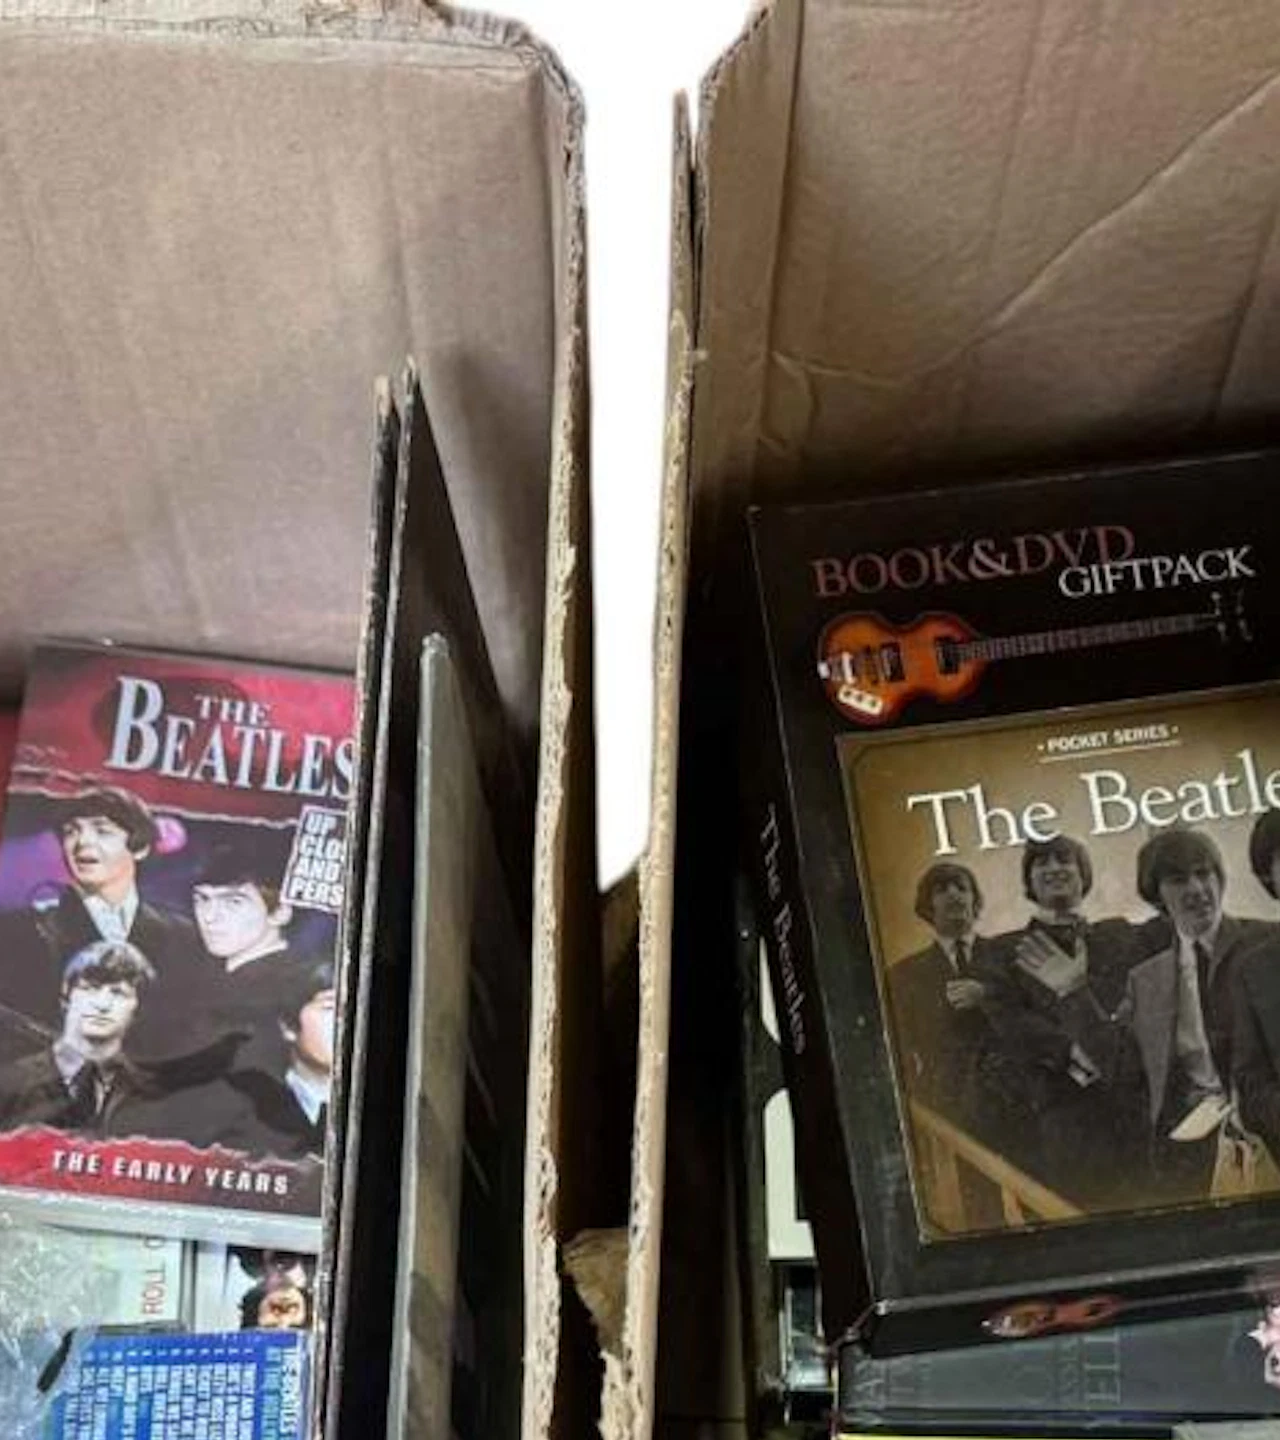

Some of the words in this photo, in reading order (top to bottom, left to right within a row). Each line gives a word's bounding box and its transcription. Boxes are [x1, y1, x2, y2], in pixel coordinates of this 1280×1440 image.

[812, 526, 1136, 598] BOOK&DVD
[1058, 546, 1254, 600] GIFTPACK
[195, 693, 268, 726] THE
[105, 676, 357, 800] BEATLES
[1047, 731, 1110, 753] POCKET
[1113, 724, 1170, 746] SERIES
[306, 810, 337, 835] UP
[907, 785, 1062, 857] The
[294, 858, 342, 881] AND
[759, 804, 783, 902] The
[772, 902, 807, 1057] Beatles
[51, 1148, 103, 1175] THE
[112, 1156, 192, 1185] EARLY
[203, 1168, 289, 1196] YEARS
